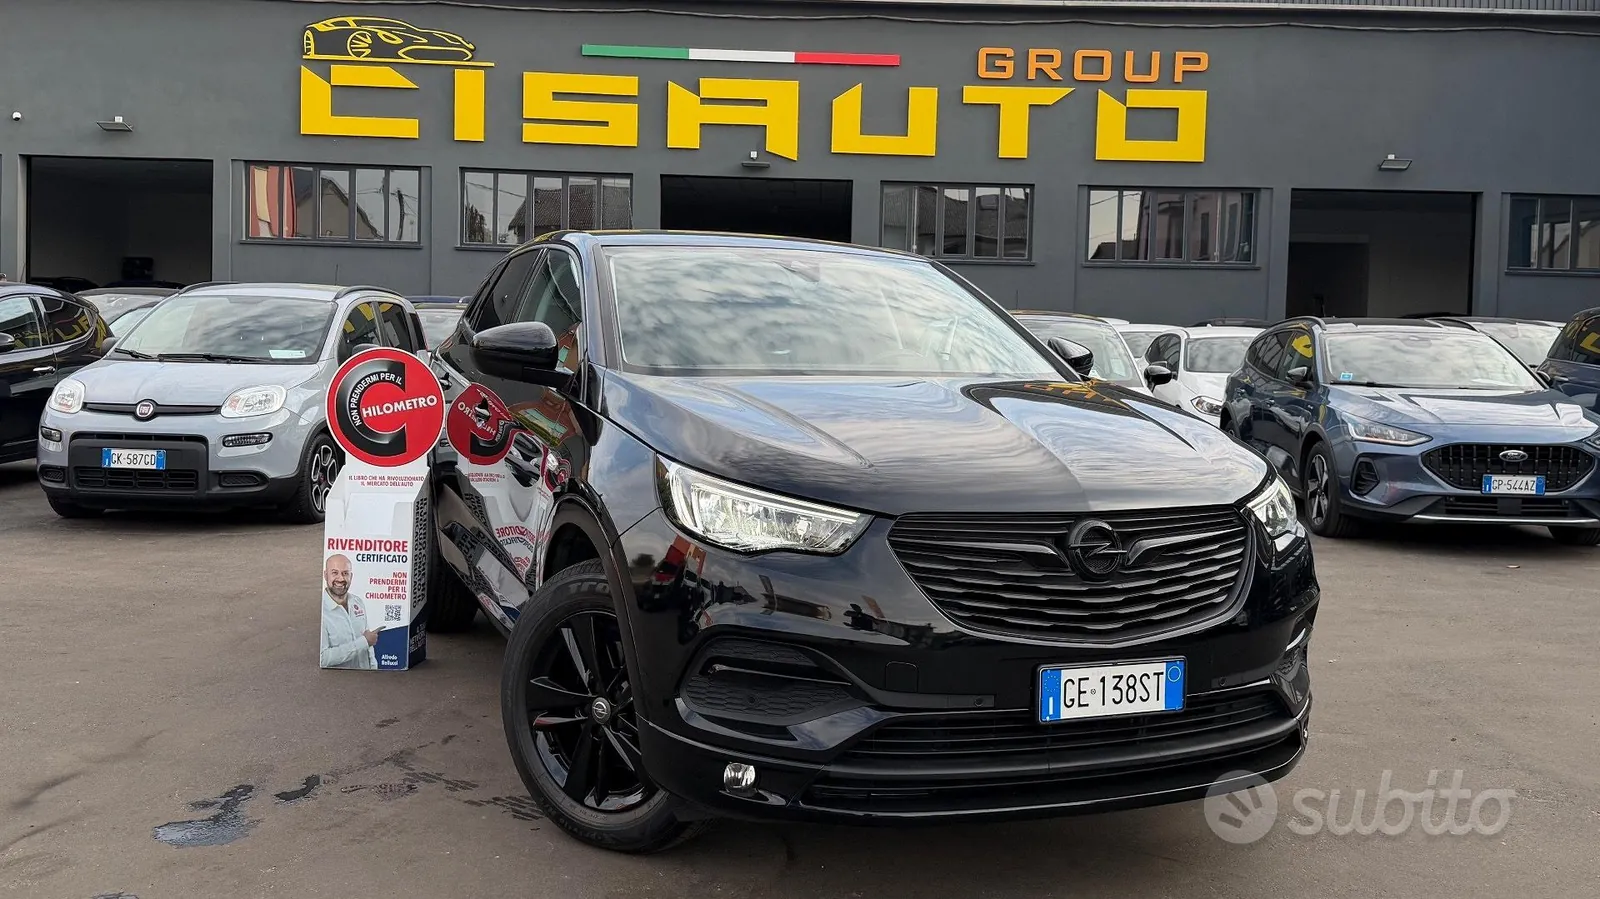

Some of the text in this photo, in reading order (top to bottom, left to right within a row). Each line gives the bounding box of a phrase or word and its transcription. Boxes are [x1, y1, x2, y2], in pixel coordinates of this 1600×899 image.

[977, 47, 1209, 83] GROUP
[300, 65, 1207, 162] CISAUTO
[351, 373, 402, 426] NON PRENDERMI PER IL
[361, 395, 437, 418] HILOMETRO
[327, 538, 408, 552] RIVENDITORE
[356, 553, 408, 563] CERTIFICATO
[365, 592, 407, 600] CHILOMETRO
